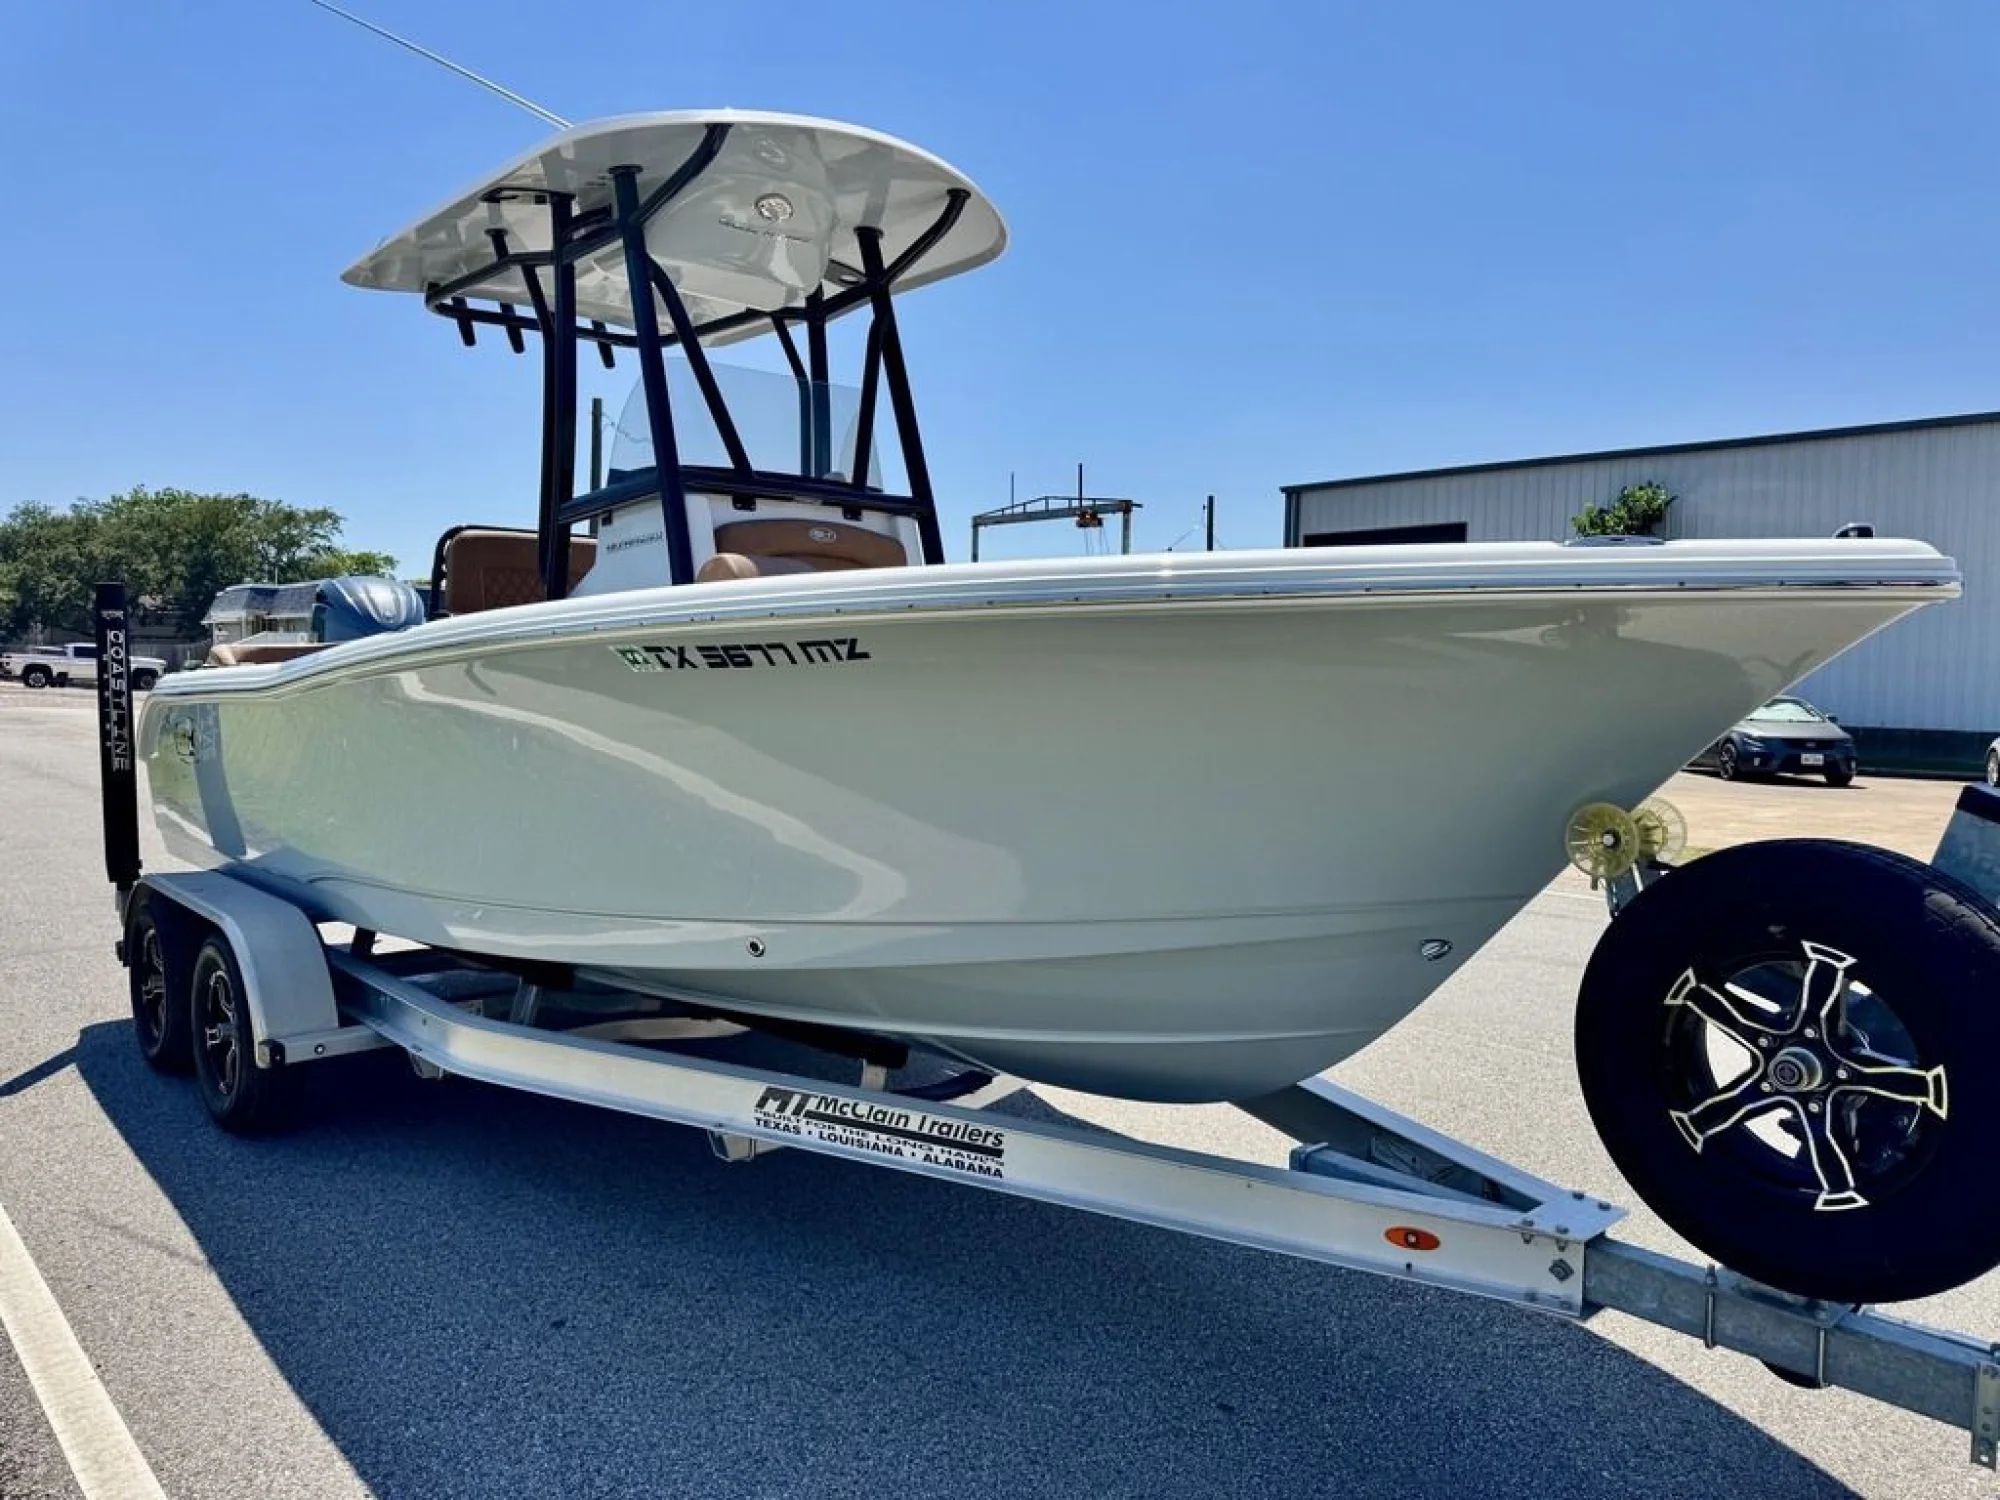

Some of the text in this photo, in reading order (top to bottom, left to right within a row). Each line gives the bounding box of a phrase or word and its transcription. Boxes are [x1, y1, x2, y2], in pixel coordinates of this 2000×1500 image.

[641, 646, 698, 669] TX
[796, 638, 872, 664] MZ
[110, 631, 128, 770] COASTLINE
[754, 1116, 1003, 1179] TEXAS LOUISIANA ALABAMA
[816, 1096, 910, 1128] McClain
[917, 1115, 1005, 1148] Trailers
